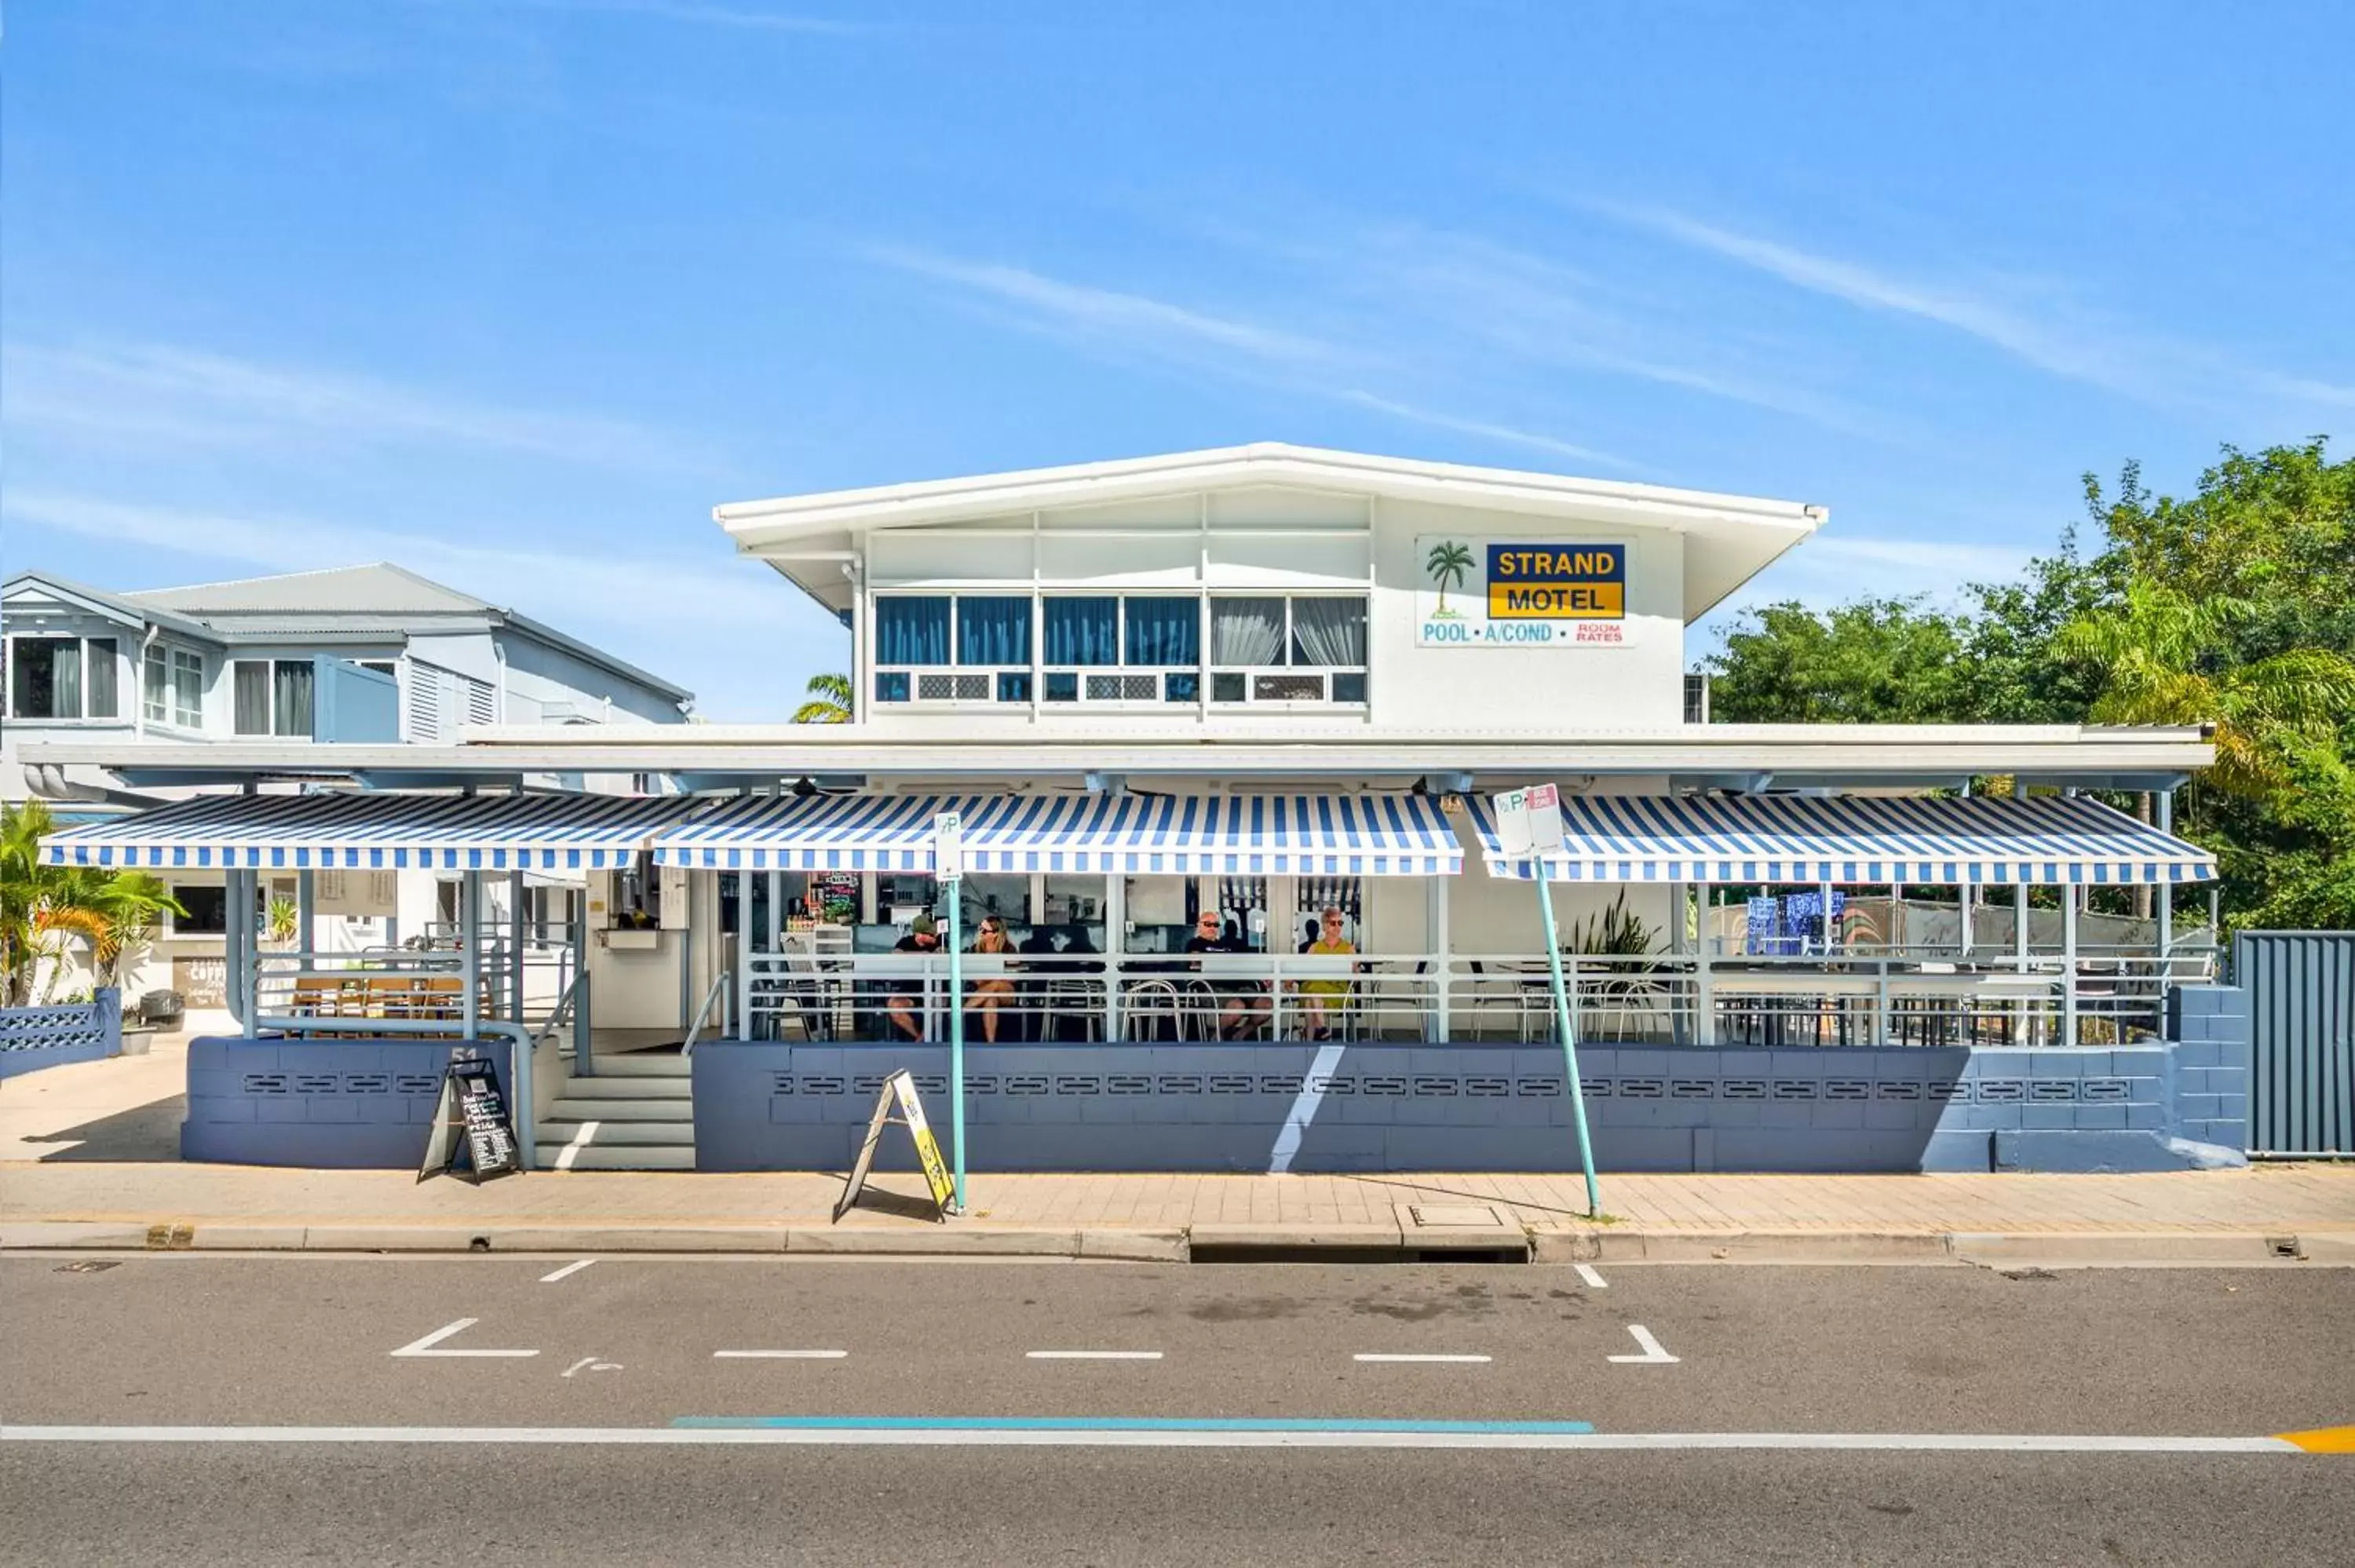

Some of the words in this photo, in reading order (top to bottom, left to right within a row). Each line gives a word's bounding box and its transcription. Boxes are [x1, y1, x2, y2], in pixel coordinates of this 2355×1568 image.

[1499, 552, 1615, 575] STRAND
[1507, 589, 1605, 611] MOTEL
[1423, 623, 1470, 641] POOL
[1484, 623, 1552, 641] A/COND
[1576, 633, 1623, 642] RATES
[1579, 624, 1620, 633] ROOM
